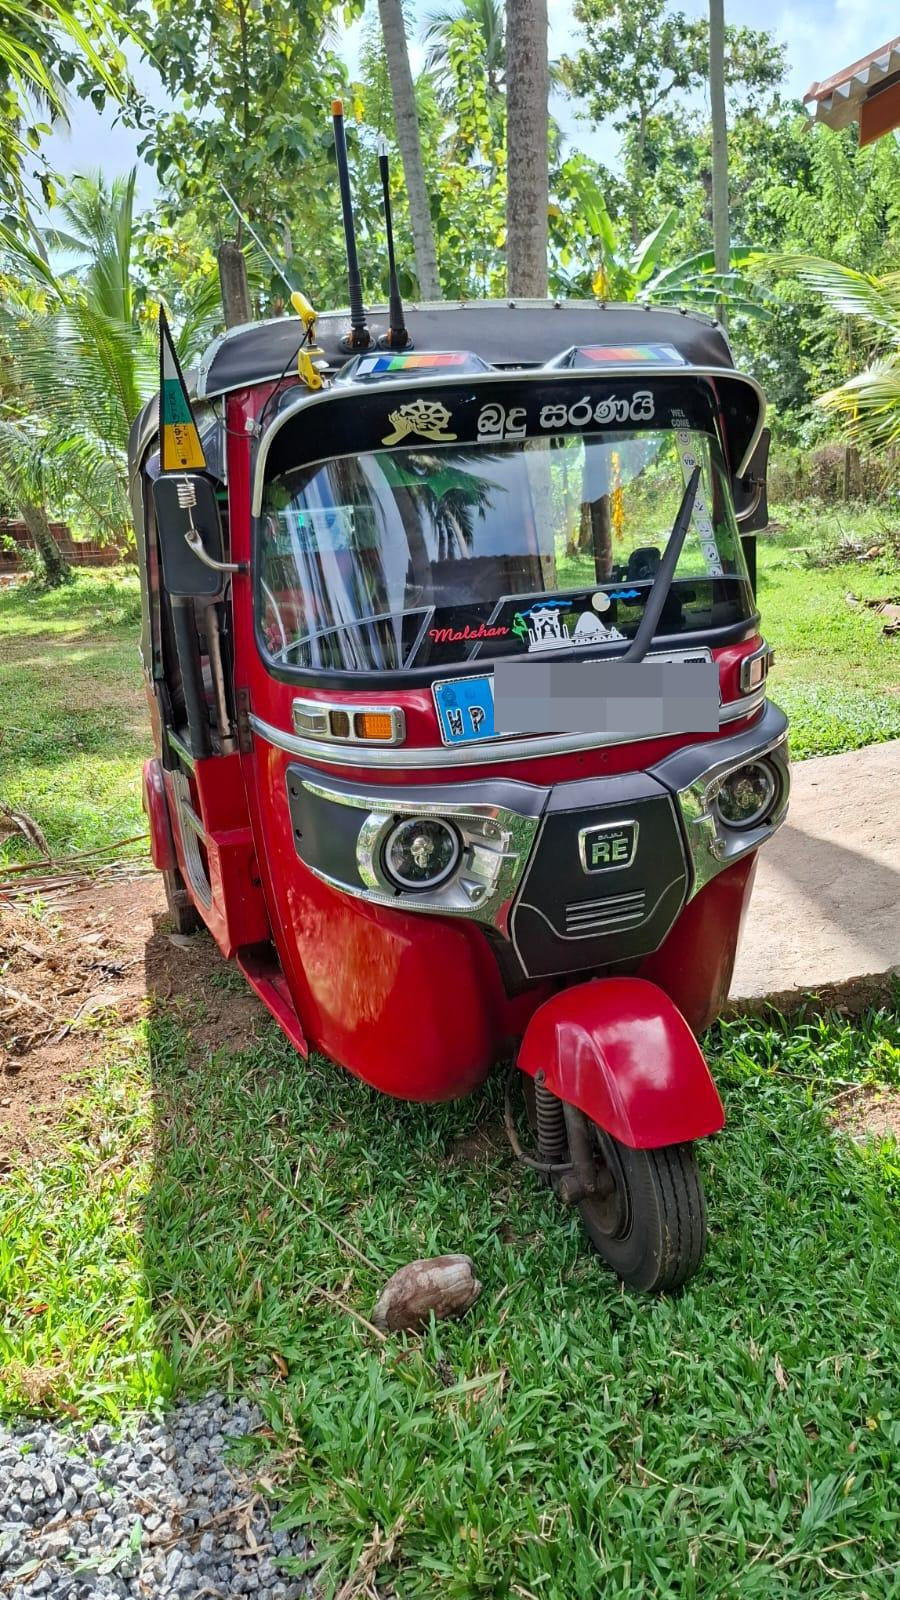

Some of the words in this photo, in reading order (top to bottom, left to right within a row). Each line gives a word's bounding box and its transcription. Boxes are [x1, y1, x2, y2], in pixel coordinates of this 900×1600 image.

[477, 402, 527, 442] බුදු
[539, 391, 656, 429] සරණයි
[670, 408, 686, 418] WEL
[671, 418, 691, 428] COME
[429, 623, 510, 643] Malshan
[597, 831, 623, 841] BAJAJ
[592, 838, 629, 865] RE
